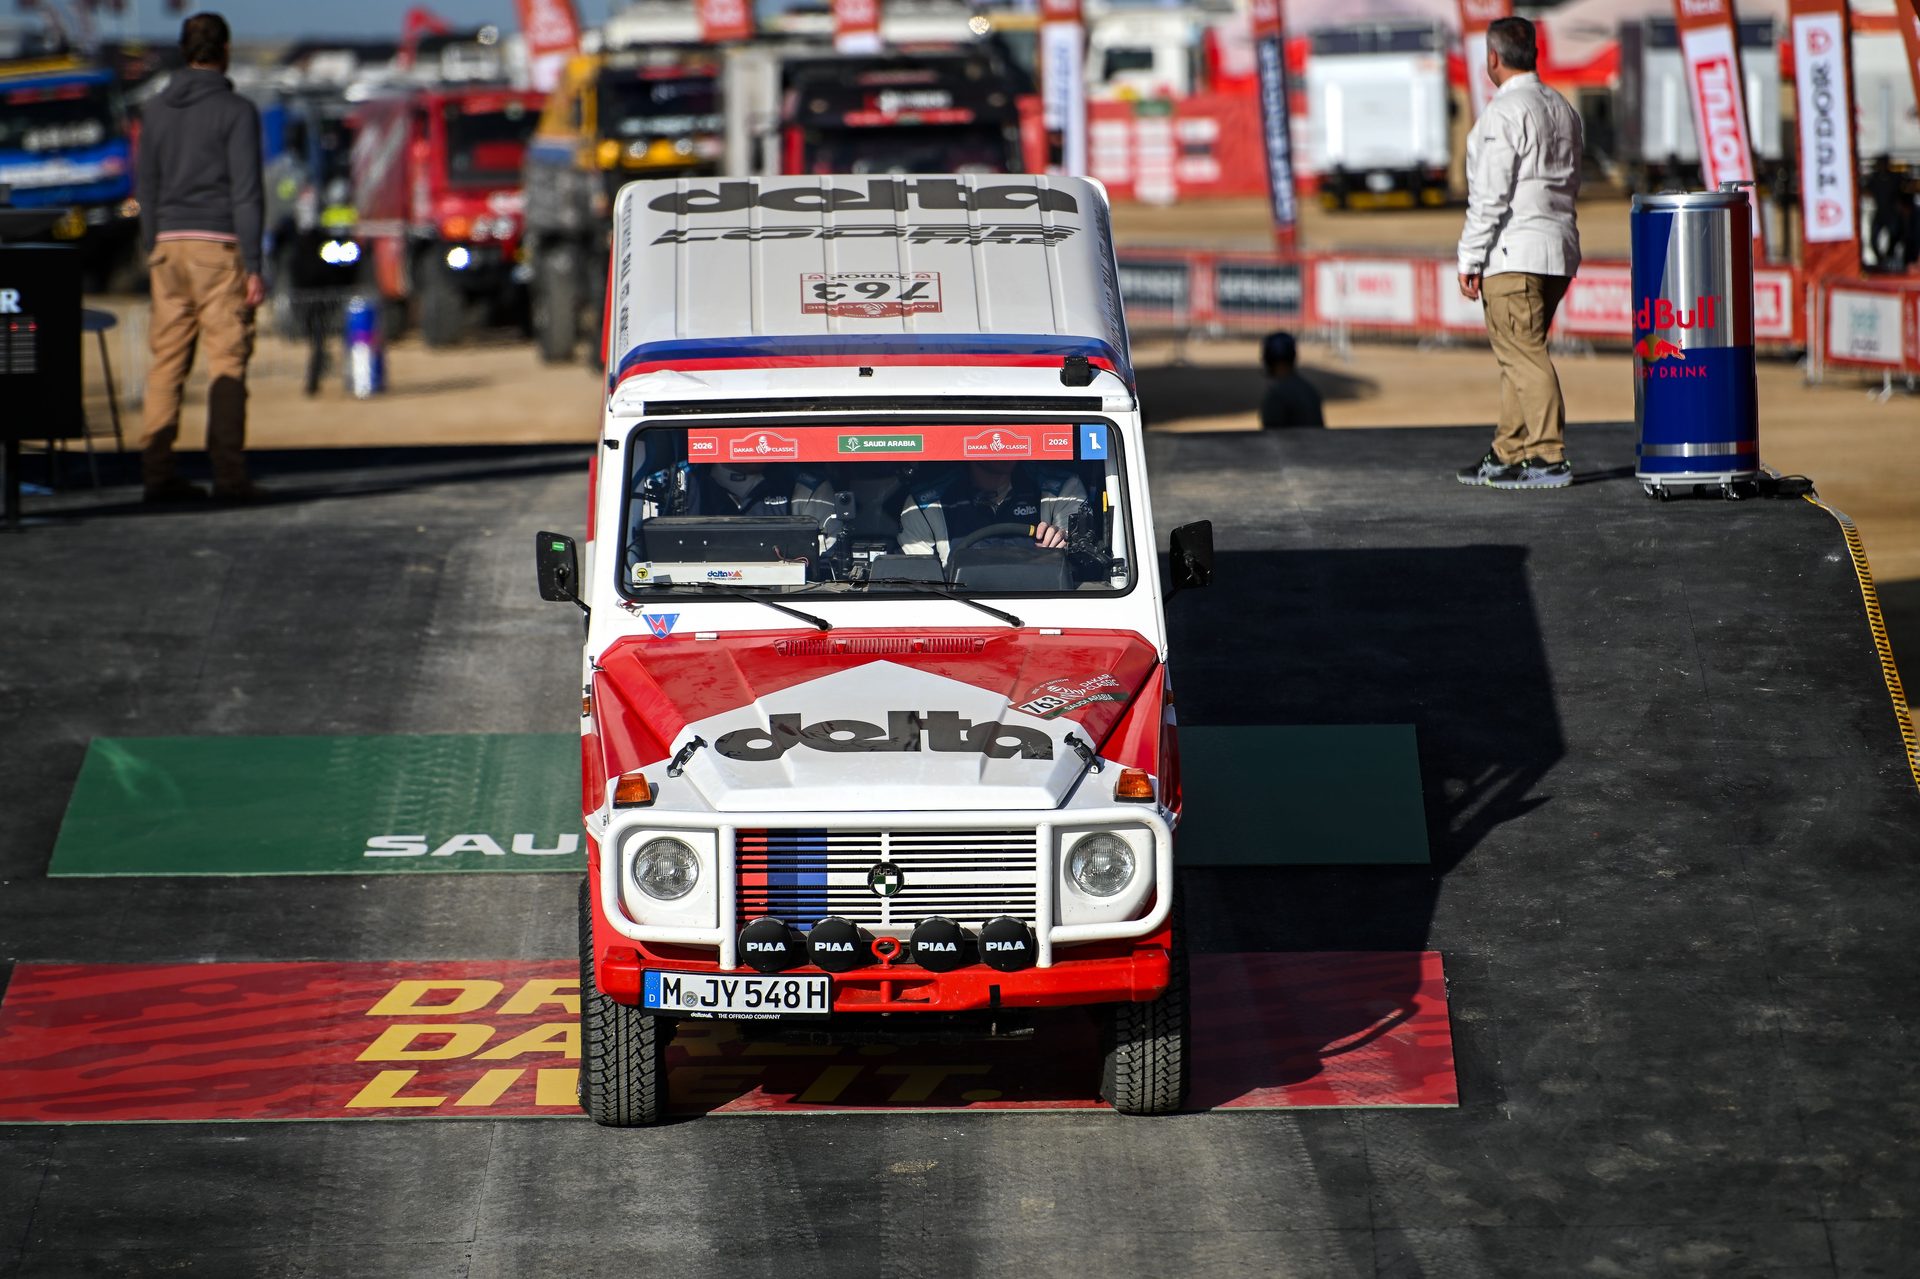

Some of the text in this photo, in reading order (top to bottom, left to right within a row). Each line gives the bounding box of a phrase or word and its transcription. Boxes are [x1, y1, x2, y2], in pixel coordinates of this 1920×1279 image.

[648, 178, 1079, 213] delta
[812, 281, 931, 303] 763
[1655, 295, 1715, 330] Bull
[1660, 365, 1707, 378] DRINK
[693, 442, 713, 450] 2026
[887, 439, 916, 447] ARABIA
[1048, 438, 1068, 446] 2026
[1013, 504, 1037, 516] delta
[1079, 673, 1112, 688] DAKAR
[1086, 679, 1120, 691] CLASSIC
[1021, 696, 1065, 714] 763
[714, 709, 1053, 762] delta
[747, 942, 786, 952] PIAA
[815, 942, 854, 952] PIAA
[917, 942, 957, 952] PIAA
[985, 941, 1025, 951] PIAA
[649, 993, 656, 1003] D
[662, 977, 681, 1006] M
[700, 979, 739, 1008] JY
